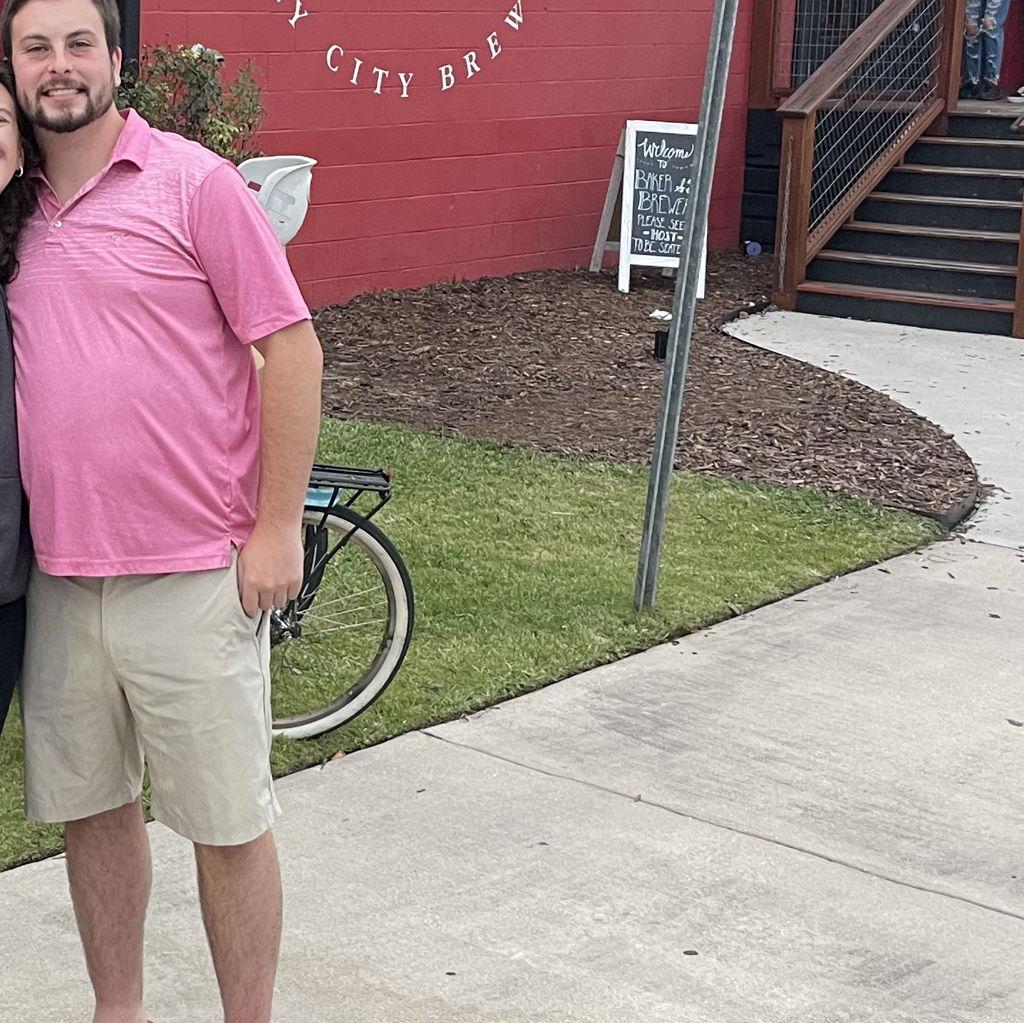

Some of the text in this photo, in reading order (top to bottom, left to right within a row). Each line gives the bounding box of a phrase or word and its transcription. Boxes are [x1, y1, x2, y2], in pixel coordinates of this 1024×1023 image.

[326, 45, 414, 98] CITY
[637, 137, 694, 159] Welcome
[635, 169, 673, 192] BAKER
[637, 214, 685, 230] PLEASE SEE
[658, 241, 682, 254] SEATE
